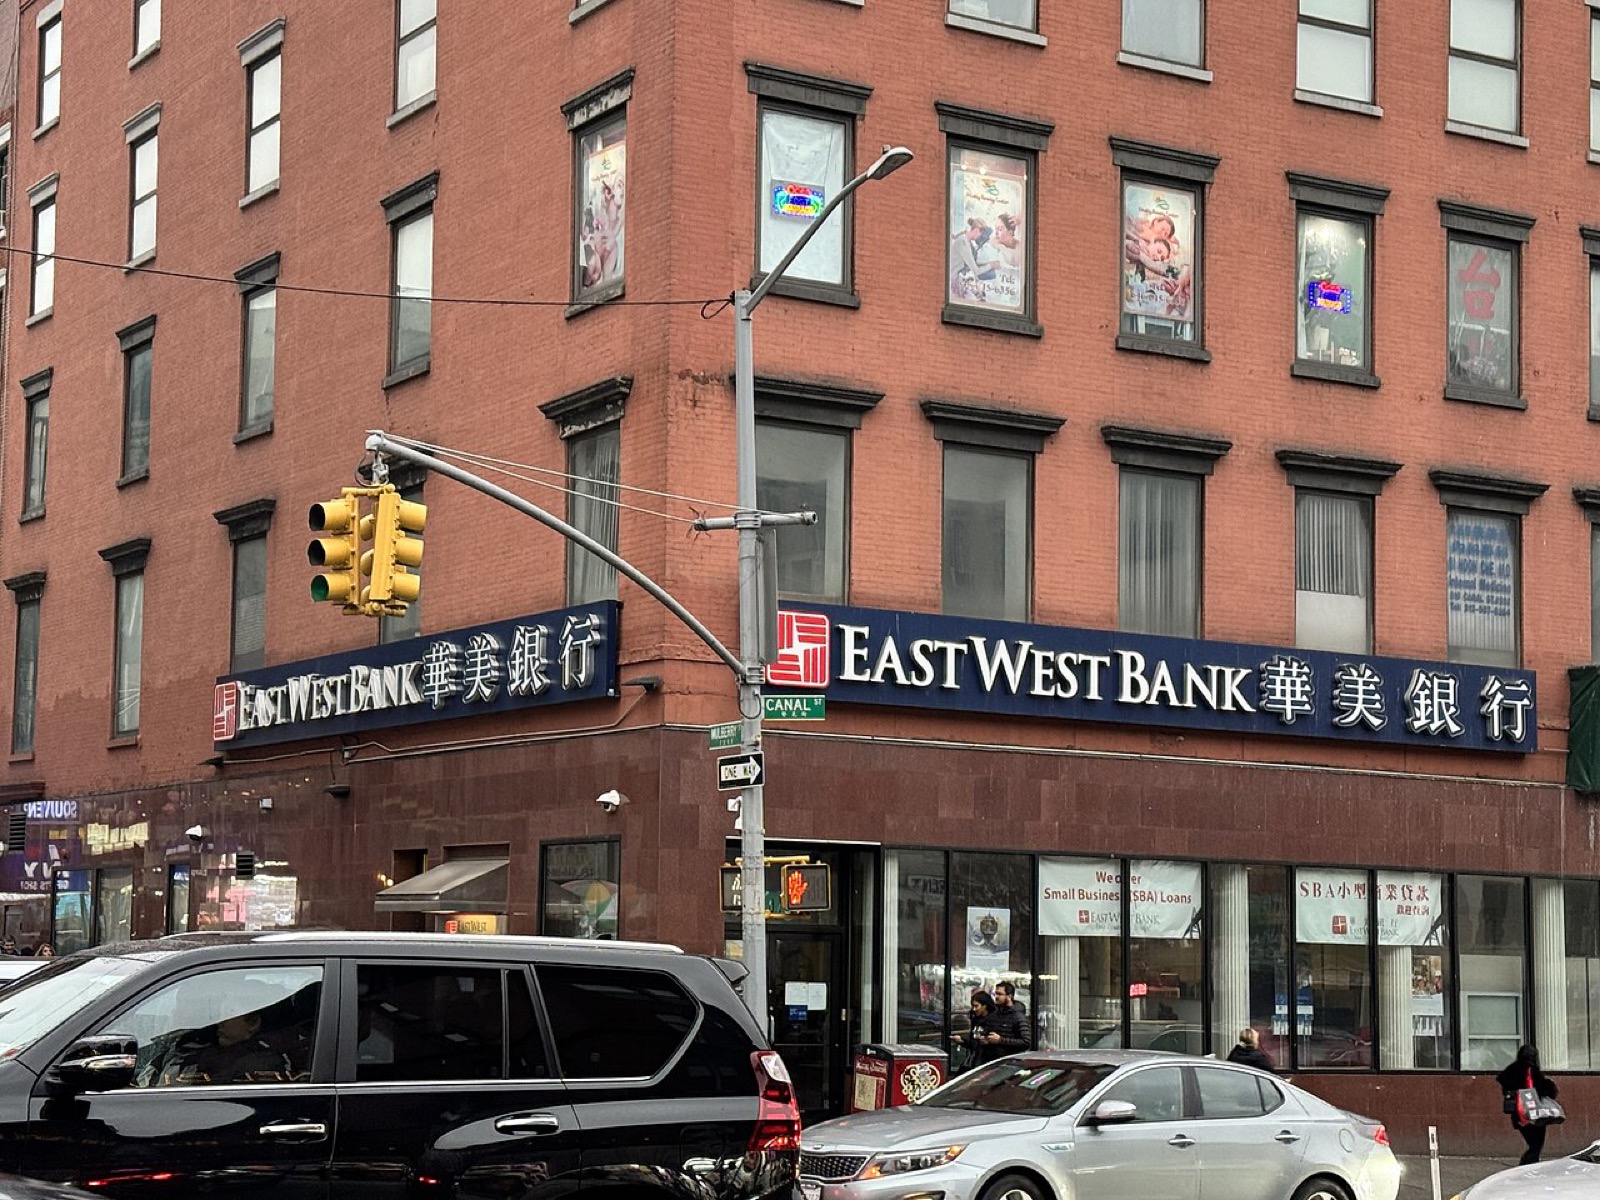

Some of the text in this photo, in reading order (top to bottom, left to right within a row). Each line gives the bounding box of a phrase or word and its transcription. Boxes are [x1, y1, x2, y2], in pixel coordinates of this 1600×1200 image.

[422, 613, 601, 710] 華美銀行
[350, 661, 425, 713] BANK
[1114, 648, 1256, 713] BANK
[766, 699, 811, 711] CANAL
[1259, 655, 1533, 743] 華美銀行
[724, 763, 756, 779] ONE WAY
[1095, 871, 1142, 885] We oer
[1044, 887, 1192, 904] Small Busines (SBA) Loans
